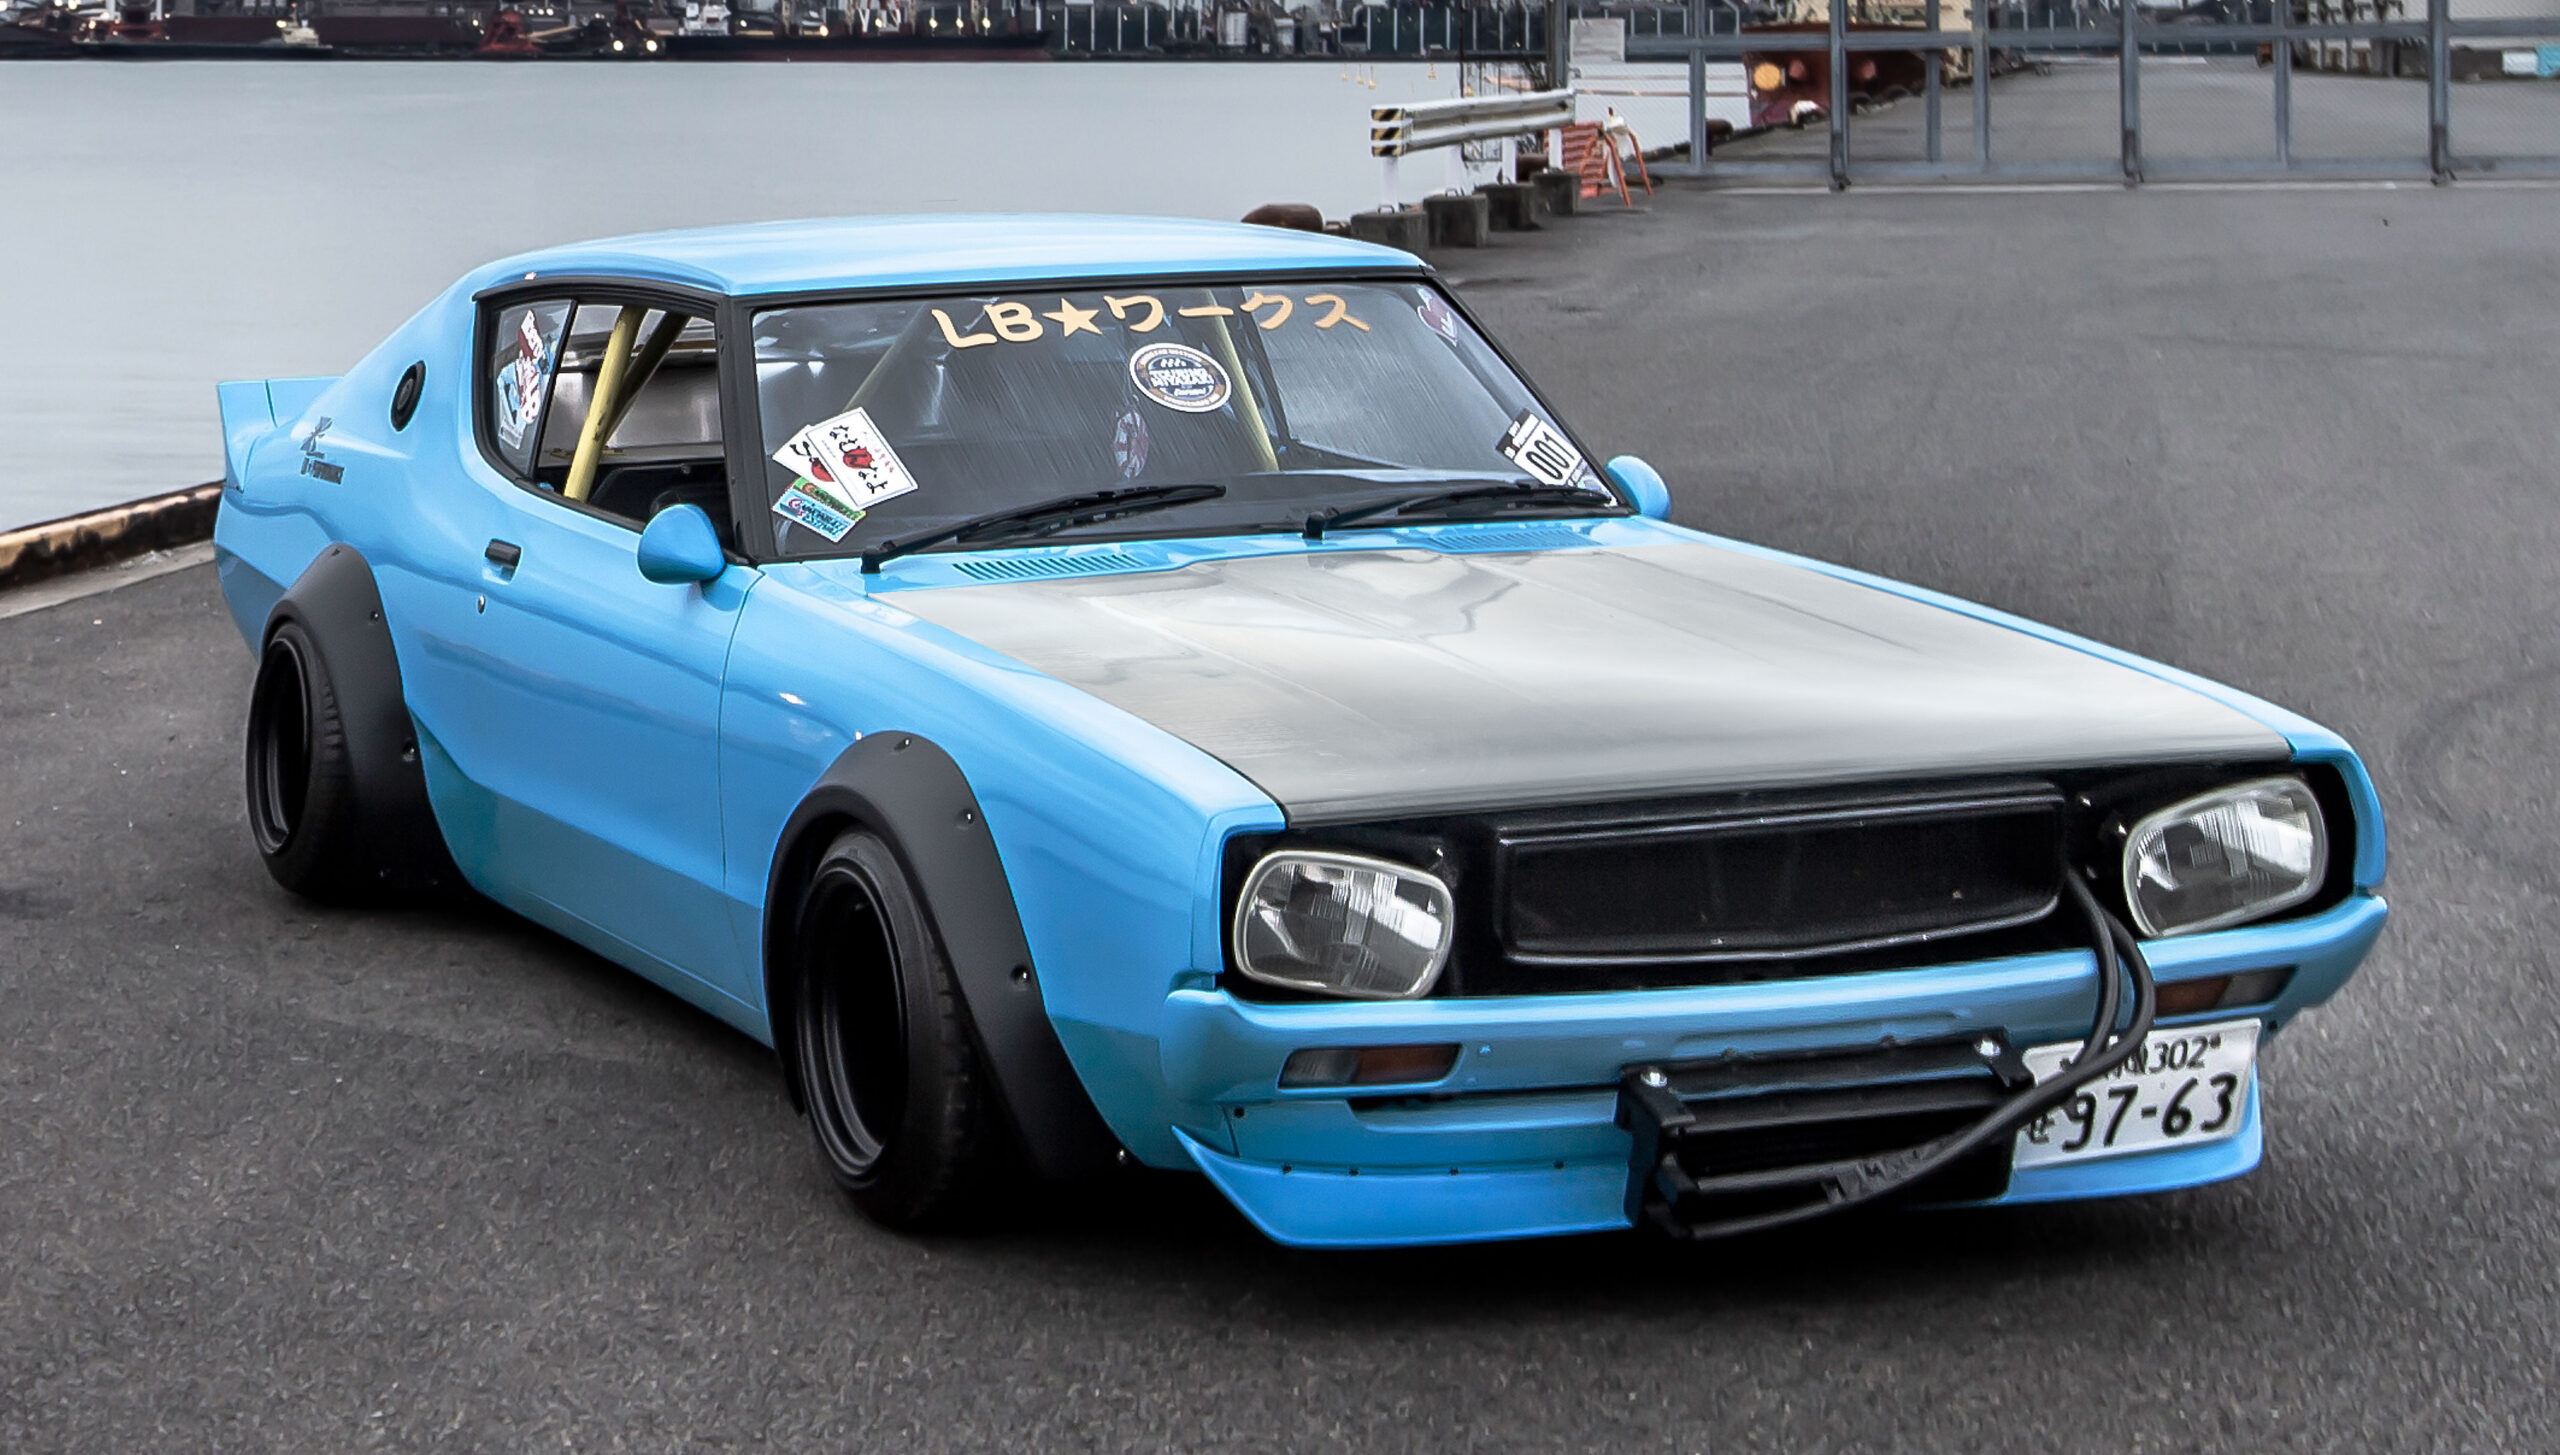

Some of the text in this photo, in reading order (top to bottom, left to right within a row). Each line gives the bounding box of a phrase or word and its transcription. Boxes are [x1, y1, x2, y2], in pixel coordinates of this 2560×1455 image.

[1526, 430, 1575, 480] 001
[2150, 1034, 2208, 1074] 302
[2062, 1071, 2238, 1153] 97-63
